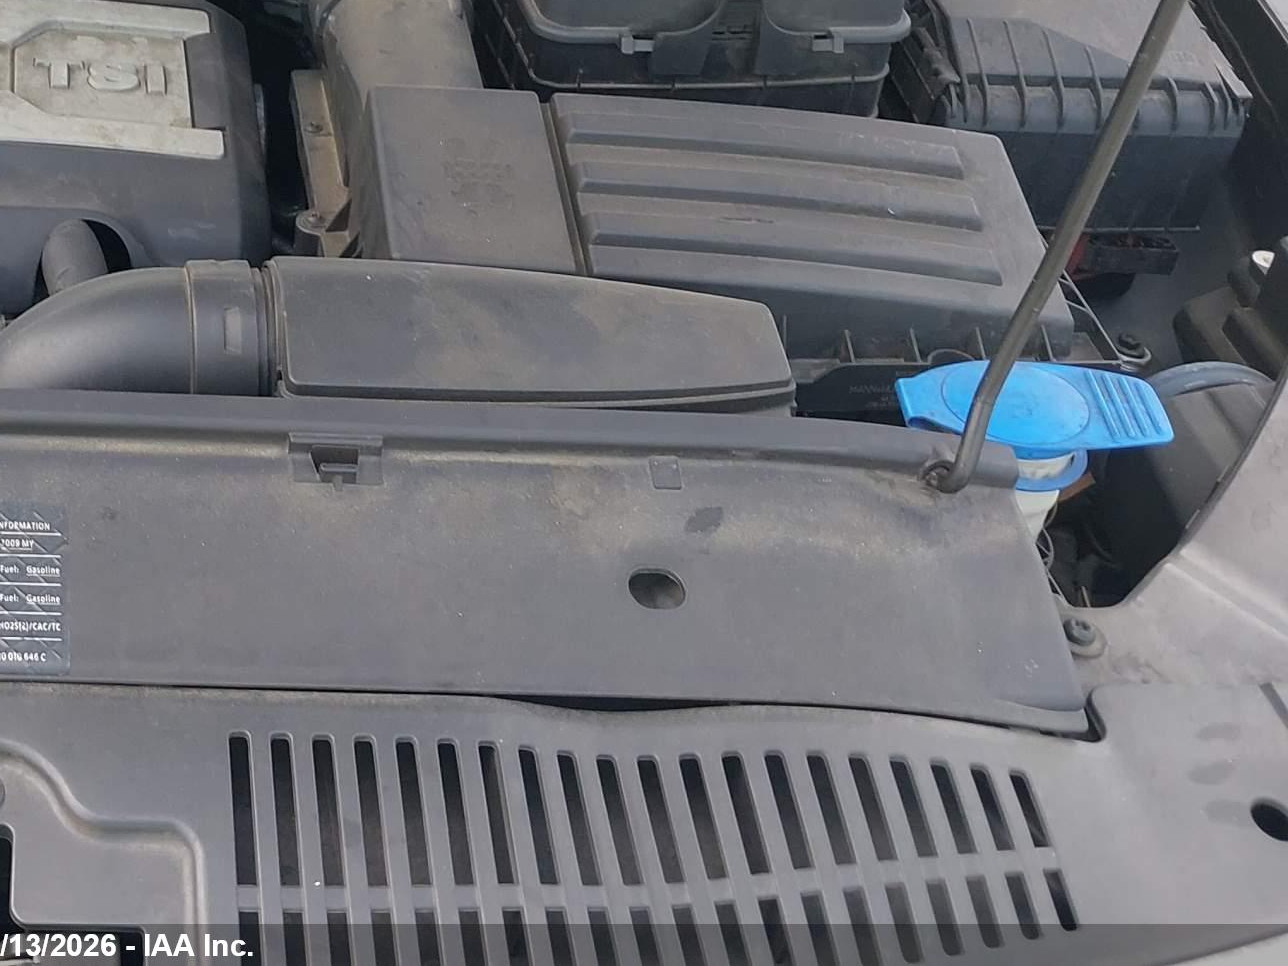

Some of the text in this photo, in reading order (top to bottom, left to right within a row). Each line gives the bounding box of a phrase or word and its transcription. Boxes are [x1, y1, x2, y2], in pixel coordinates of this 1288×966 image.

[33, 57, 167, 96] TSI
[22, 539, 34, 547] MY
[26, 565, 60, 574] Gasoline
[26, 594, 61, 603] Gasoline
[40, 653, 47, 662] C
